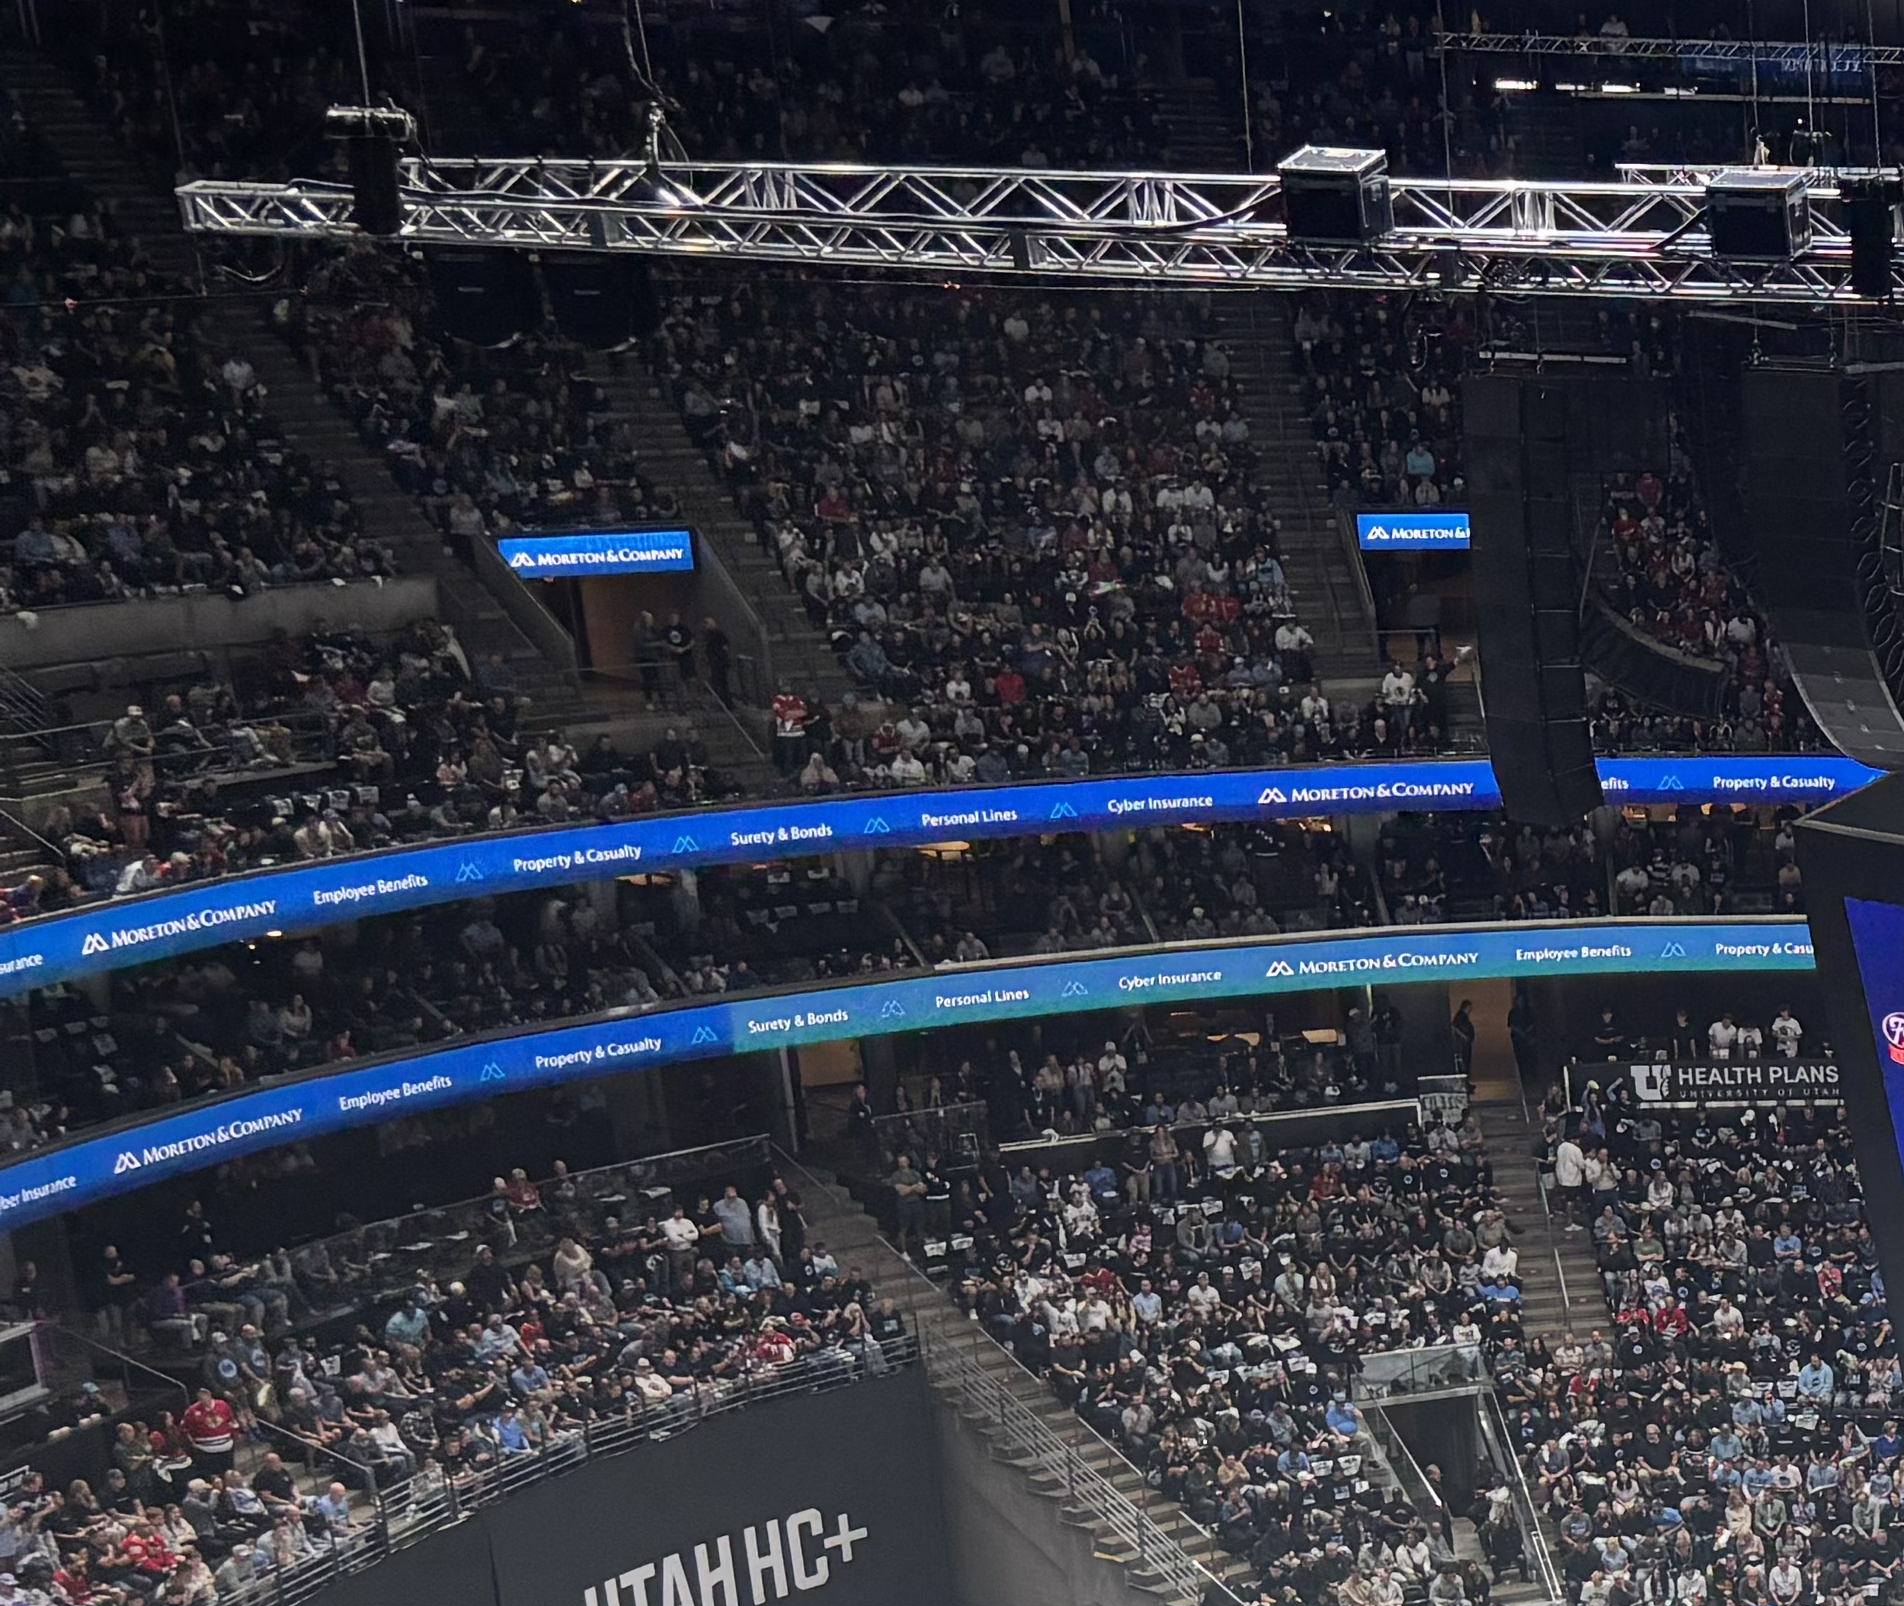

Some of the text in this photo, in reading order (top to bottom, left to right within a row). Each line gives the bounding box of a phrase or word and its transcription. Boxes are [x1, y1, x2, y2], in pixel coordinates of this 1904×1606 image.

[1108, 792, 1213, 814] Cyber Insurance
[922, 808, 1018, 828] Personal Lines
[731, 823, 833, 846] Surety & Bonds
[513, 843, 641, 873] Property & Casualty
[935, 988, 1029, 1009] Personal Lines
[1678, 1065, 1839, 1085] HEALTH PLANS
[745, 1507, 868, 1606] HC+
